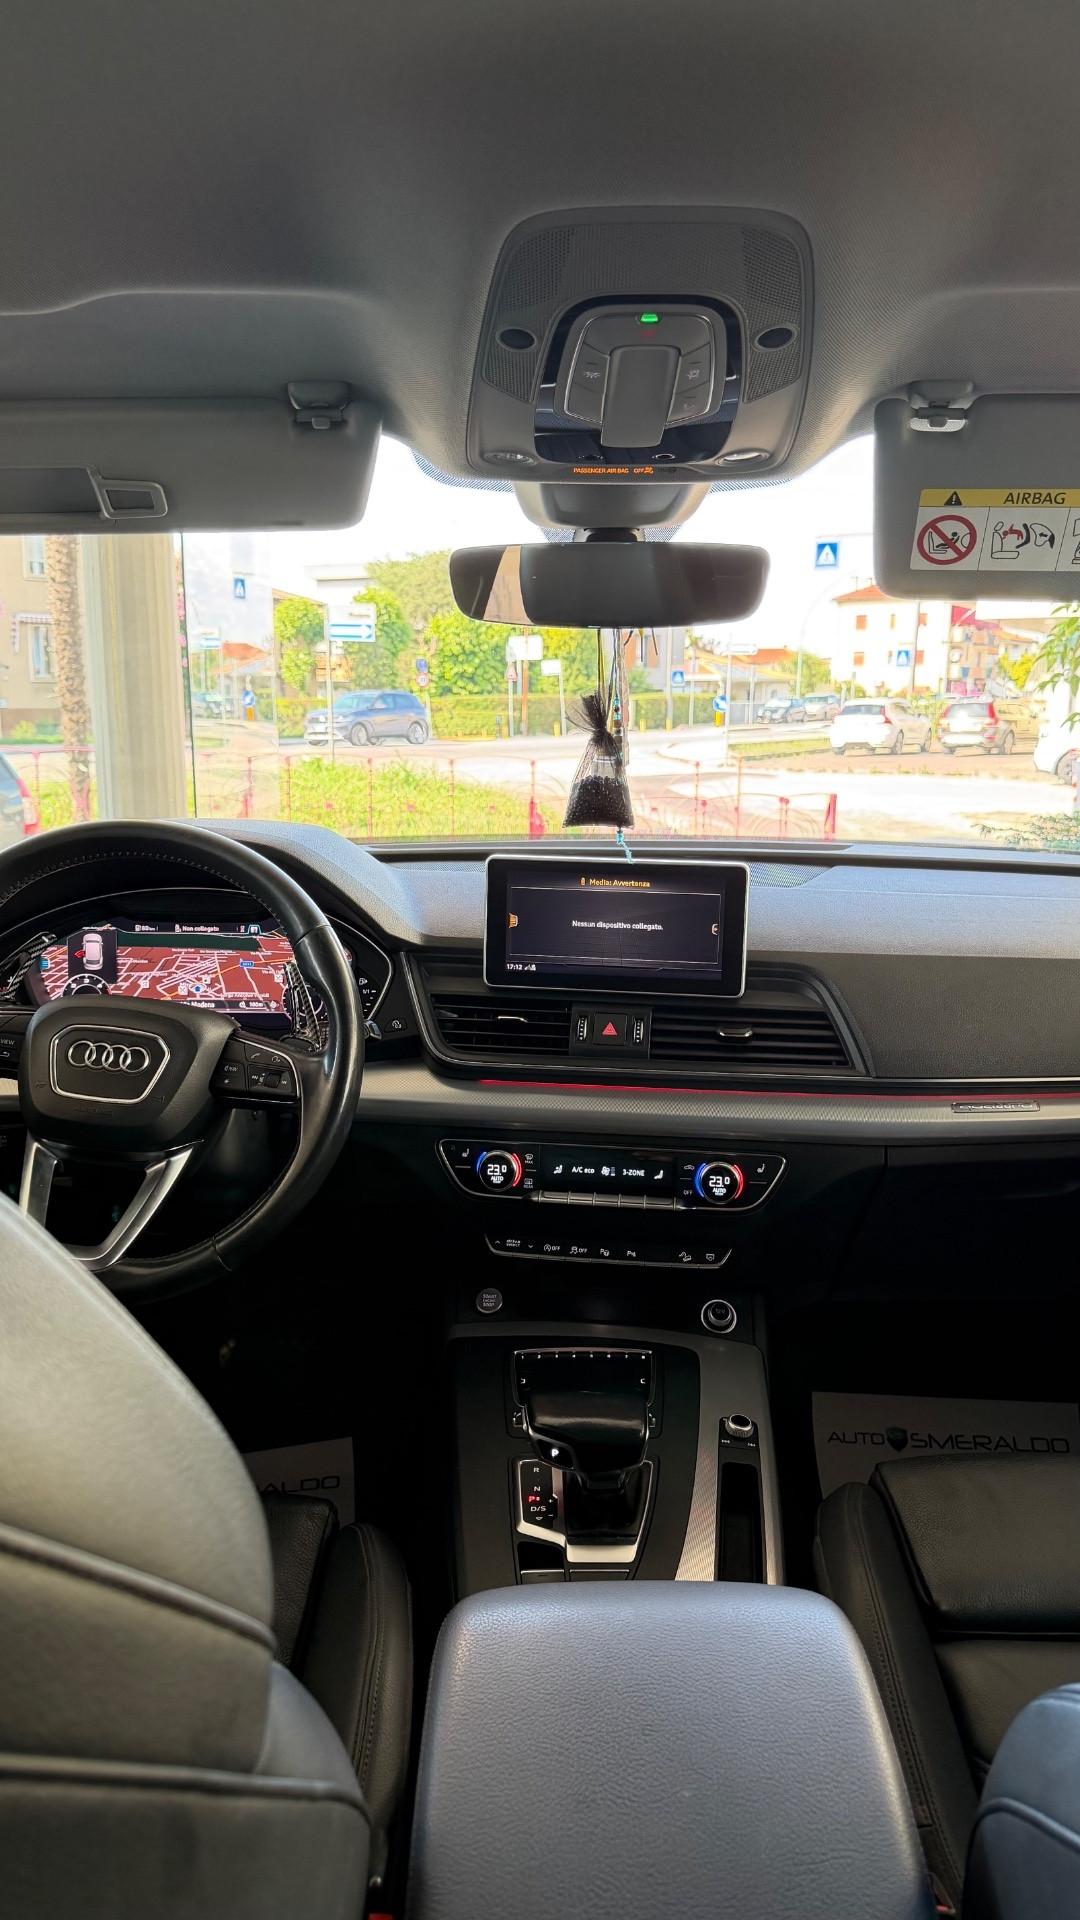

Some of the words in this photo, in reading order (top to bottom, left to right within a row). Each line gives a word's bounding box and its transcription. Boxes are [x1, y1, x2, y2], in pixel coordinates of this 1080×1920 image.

[1003, 492, 1067, 505] AIRBAG
[589, 878, 612, 886] Media:
[572, 920, 596, 928] Nessun
[596, 921, 631, 930] dispositivo
[631, 922, 664, 931] collegato.
[506, 963, 523, 971] 17:12
[622, 1168, 645, 1177] 3-ZONE
[827, 1431, 885, 1446] AUTO
[911, 1432, 1071, 1454] SMERALDO
[551, 1448, 560, 1458] P
[257, 1475, 340, 1494] ALDO
